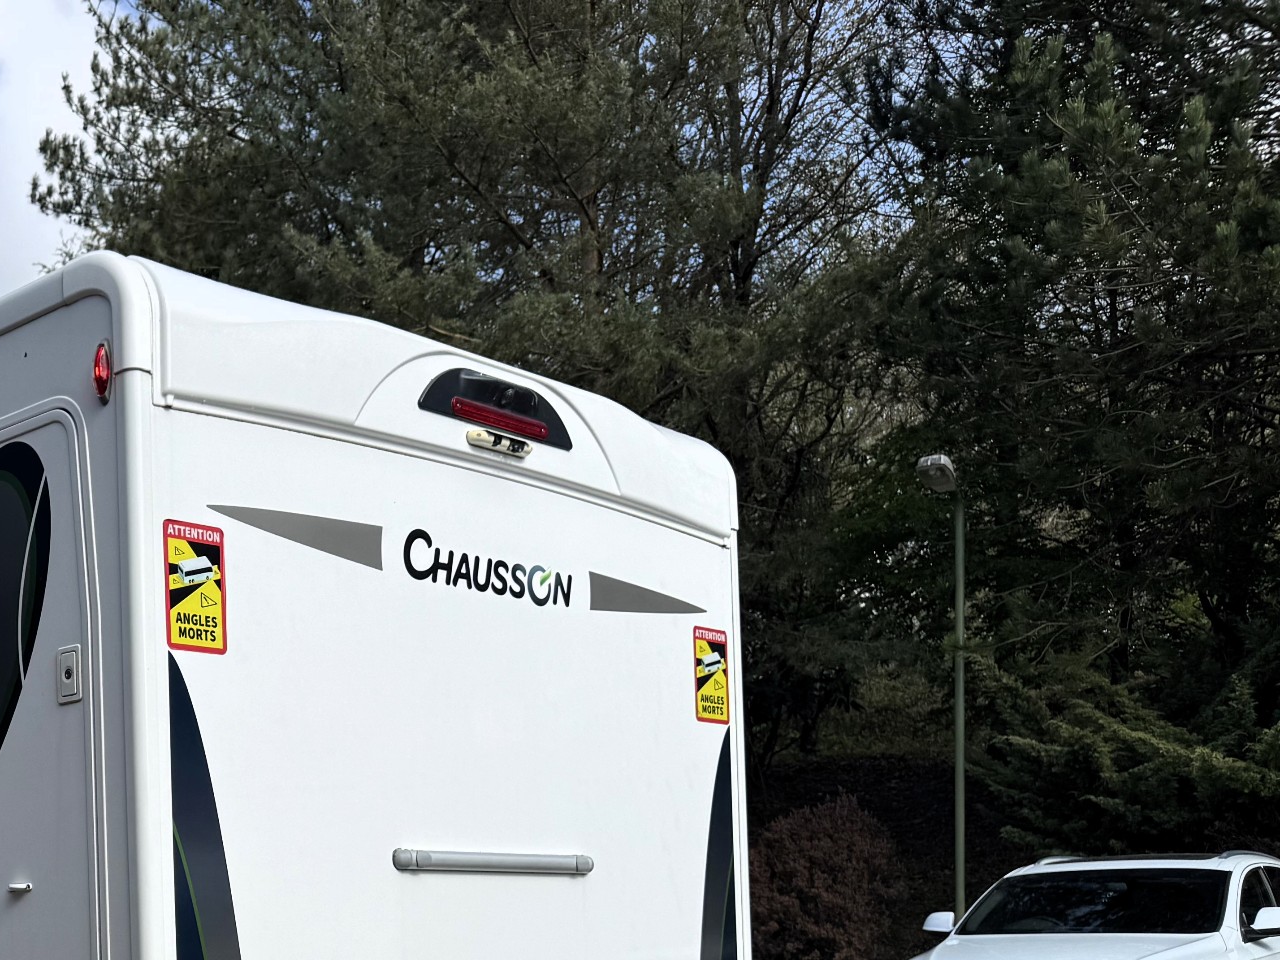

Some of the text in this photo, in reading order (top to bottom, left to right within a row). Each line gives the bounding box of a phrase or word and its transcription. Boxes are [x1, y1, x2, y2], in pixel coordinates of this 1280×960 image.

[167, 524, 220, 543] ATTENTION
[403, 528, 573, 607] CHAUSSON
[175, 611, 218, 629] ANGLES
[178, 626, 217, 642] MORTS
[695, 629, 726, 642] ATTENTION
[700, 693, 725, 706] ANGLES
[701, 704, 724, 716] MORTS
